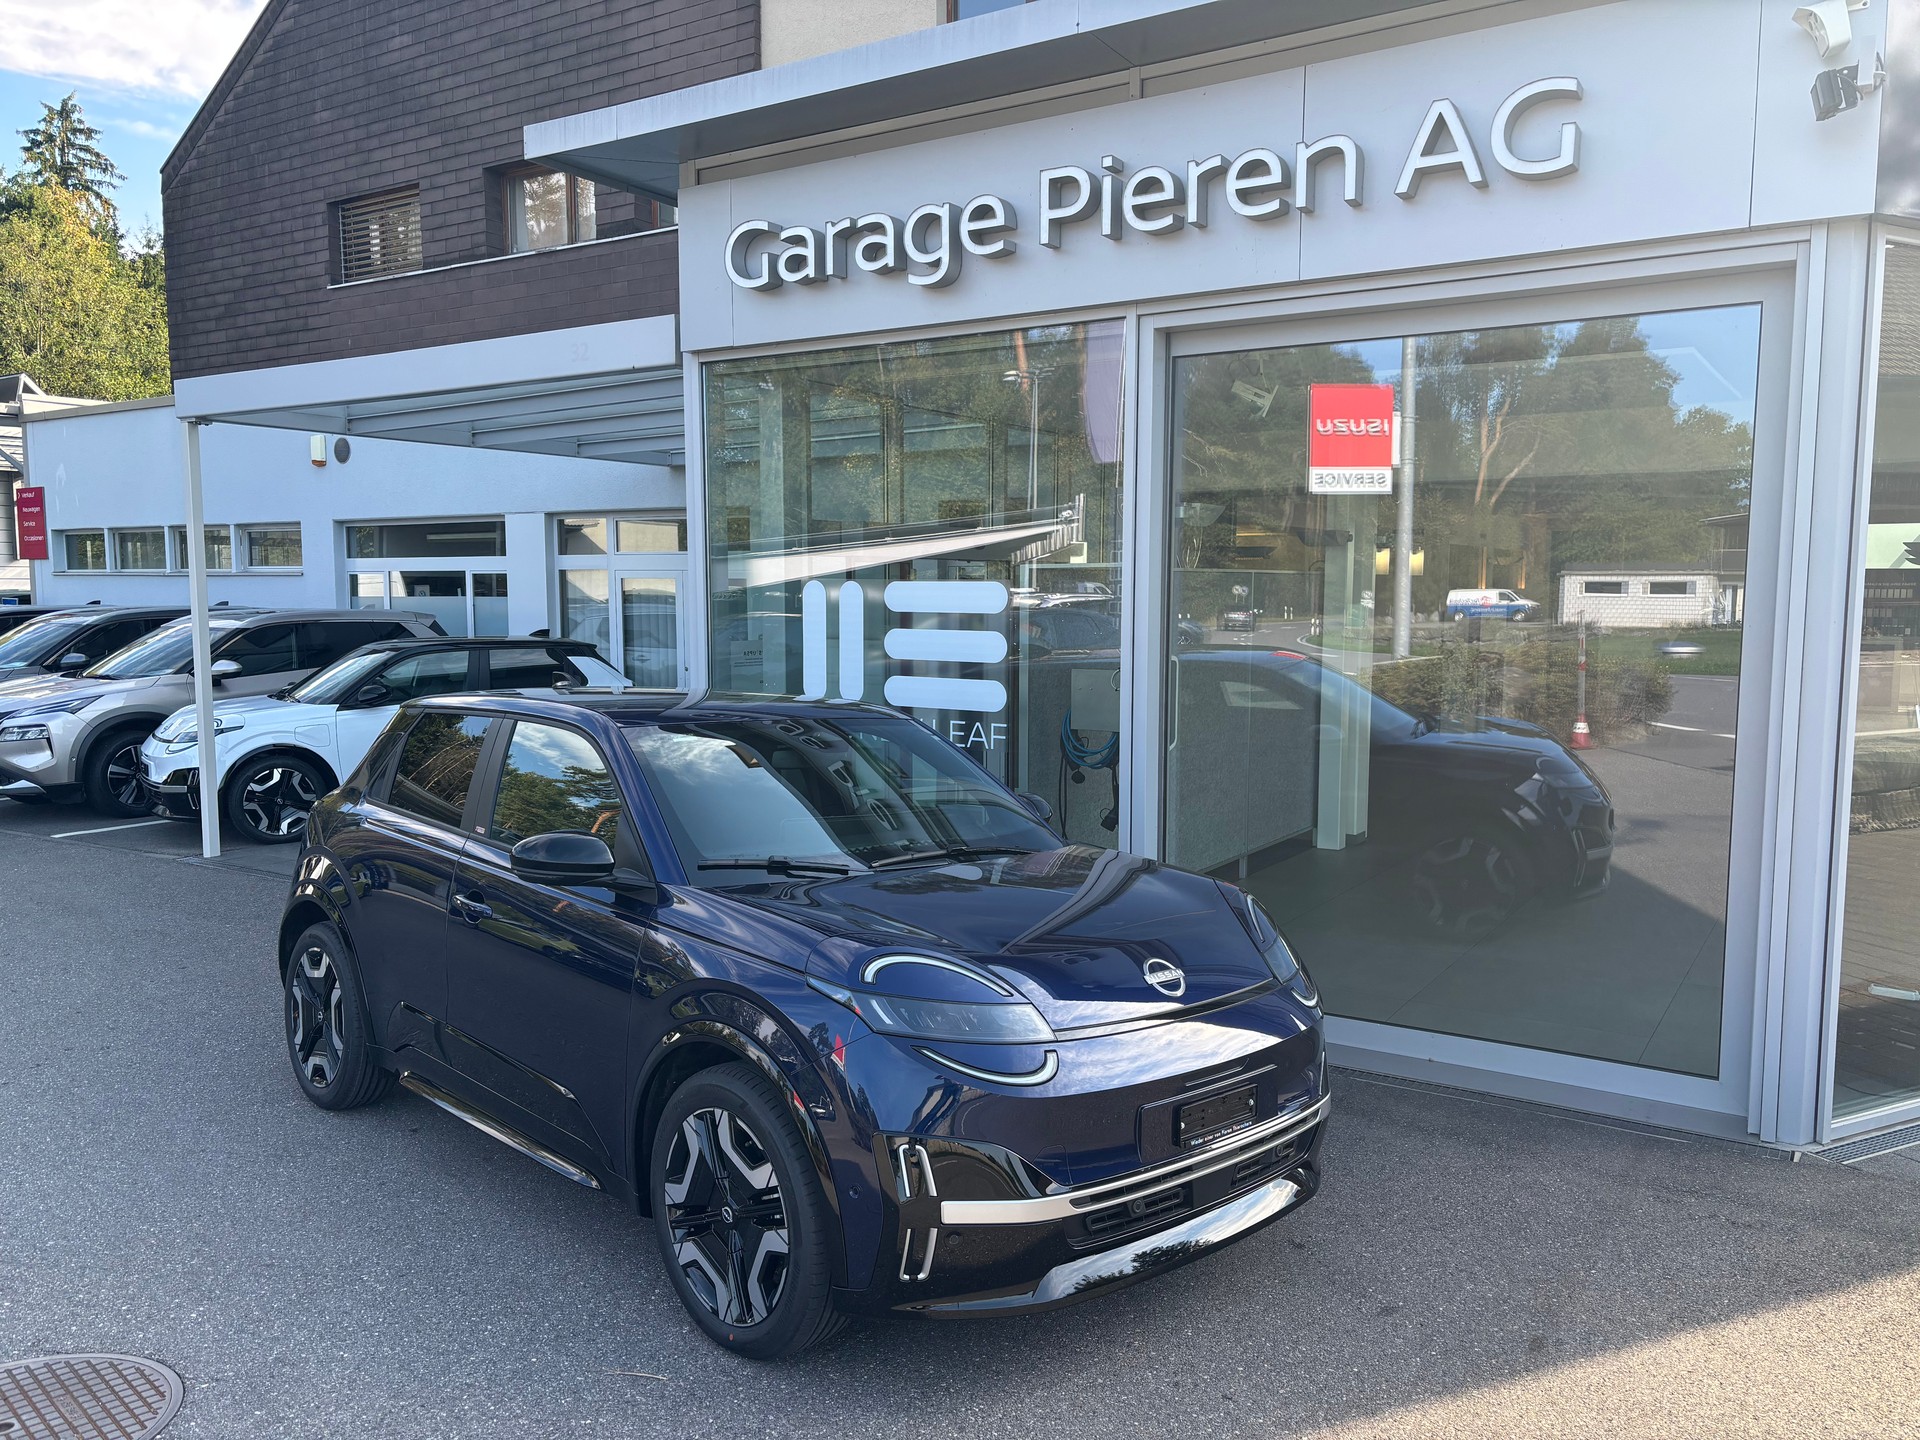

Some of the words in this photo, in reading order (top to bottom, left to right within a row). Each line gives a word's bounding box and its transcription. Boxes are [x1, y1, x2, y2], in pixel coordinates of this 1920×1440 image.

[724, 193, 1017, 291] Garage
[1039, 134, 1365, 249] Pieren
[1394, 77, 1584, 200] AG
[1146, 968, 1185, 983] NISSAN
